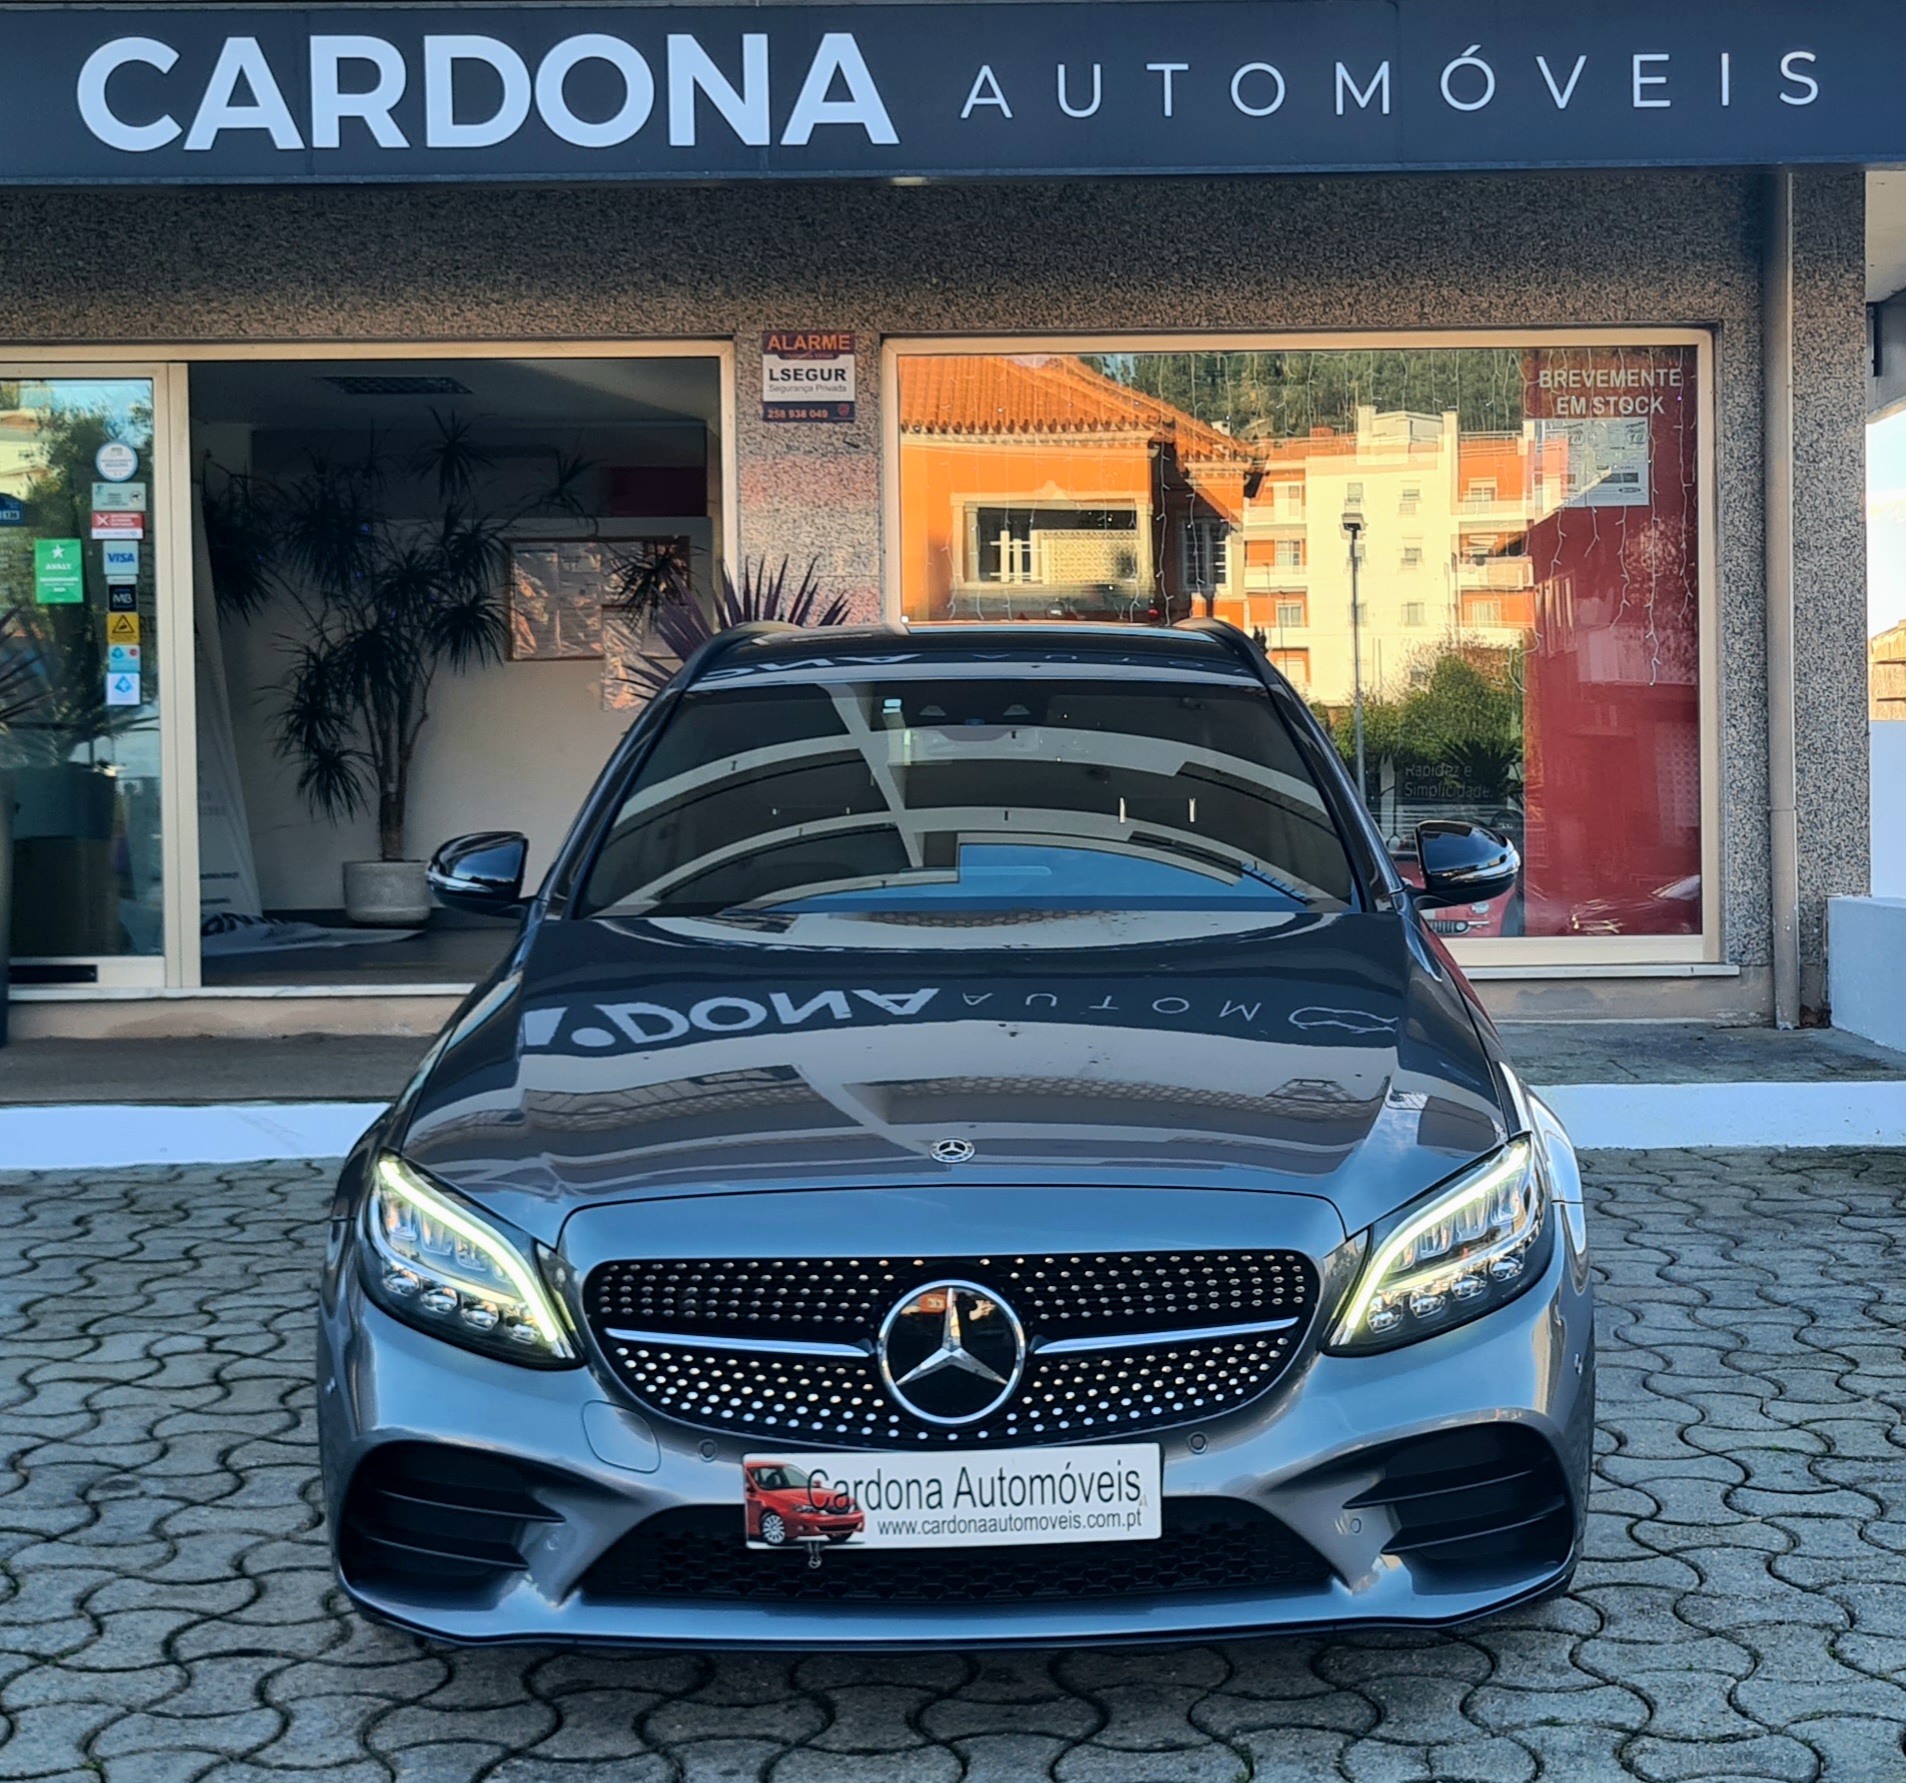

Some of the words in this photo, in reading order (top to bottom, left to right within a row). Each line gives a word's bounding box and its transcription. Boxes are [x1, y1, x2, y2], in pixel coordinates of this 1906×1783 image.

[77, 32, 901, 152] CARDONA
[960, 44, 1820, 119] AUTOMÓVEIS
[767, 334, 851, 351] ALARME
[768, 367, 847, 382] LSEGUR
[1539, 368, 1683, 388] BREVEMENTE
[768, 383, 813, 394] Segurança
[815, 383, 847, 393] Privada
[1556, 396, 1587, 416] EM
[1592, 396, 1665, 415] STOCK
[107, 552, 135, 563] VISA
[112, 592, 133, 604] MB
[1464, 765, 1473, 777] e
[806, 1468, 944, 1511] Cardona
[953, 1459, 1142, 1508] Automóveis
[877, 1508, 1142, 1536] www.cardonaautomoveis.com.pt
